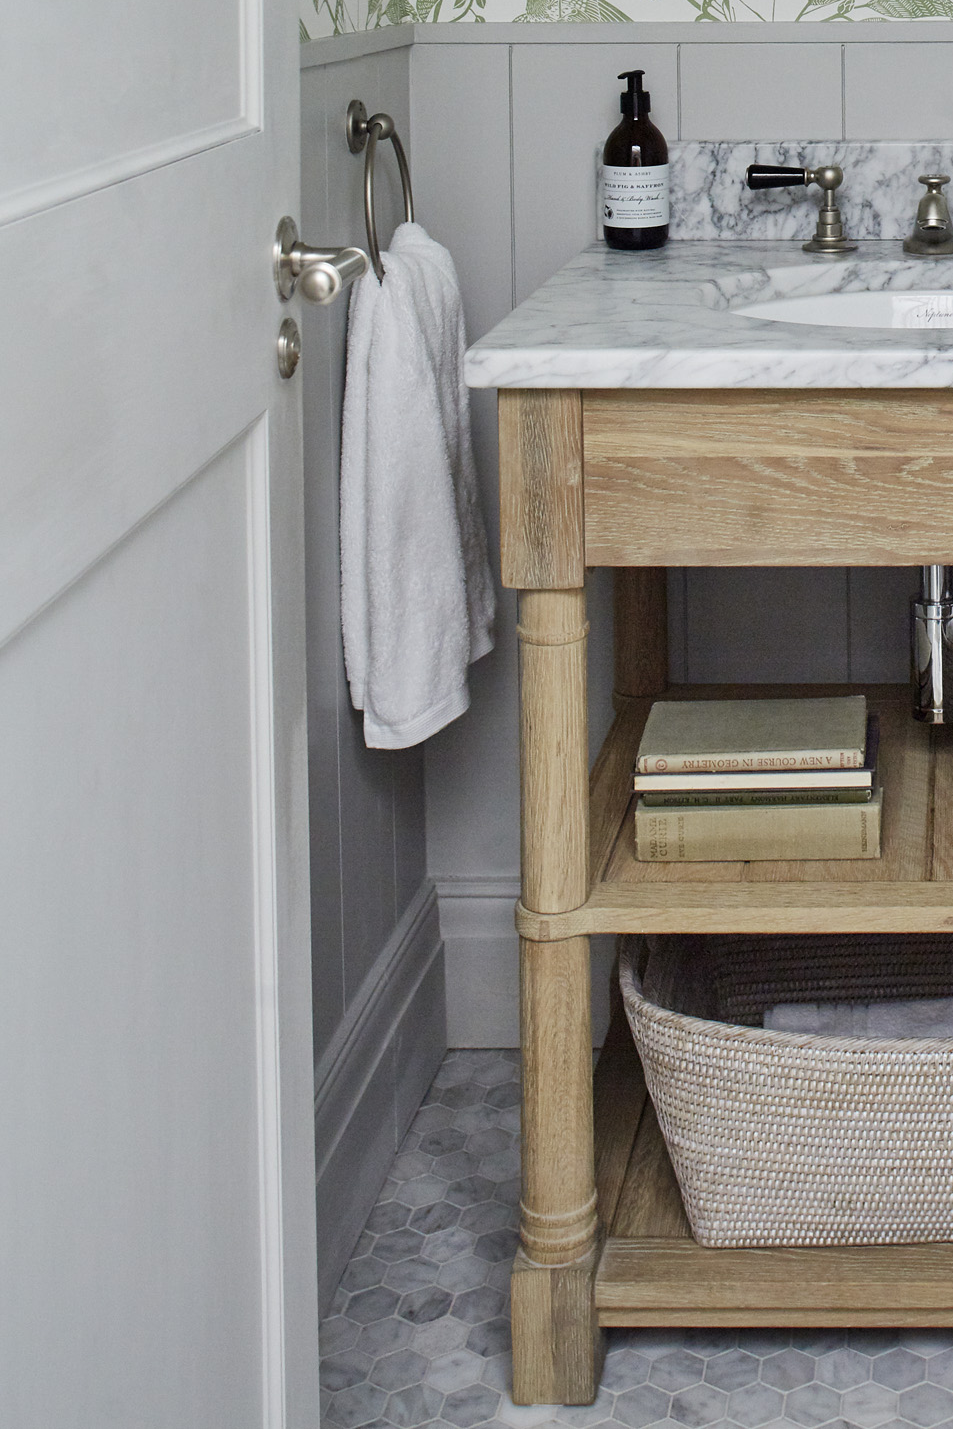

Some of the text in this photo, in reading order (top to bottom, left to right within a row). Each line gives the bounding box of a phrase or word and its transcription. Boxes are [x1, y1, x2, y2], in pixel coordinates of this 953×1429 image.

[681, 756, 833, 769] A NEW COURSE IN GEOMETRY
[650, 817, 658, 858] MADAME
[659, 818, 667, 857] CURIE
